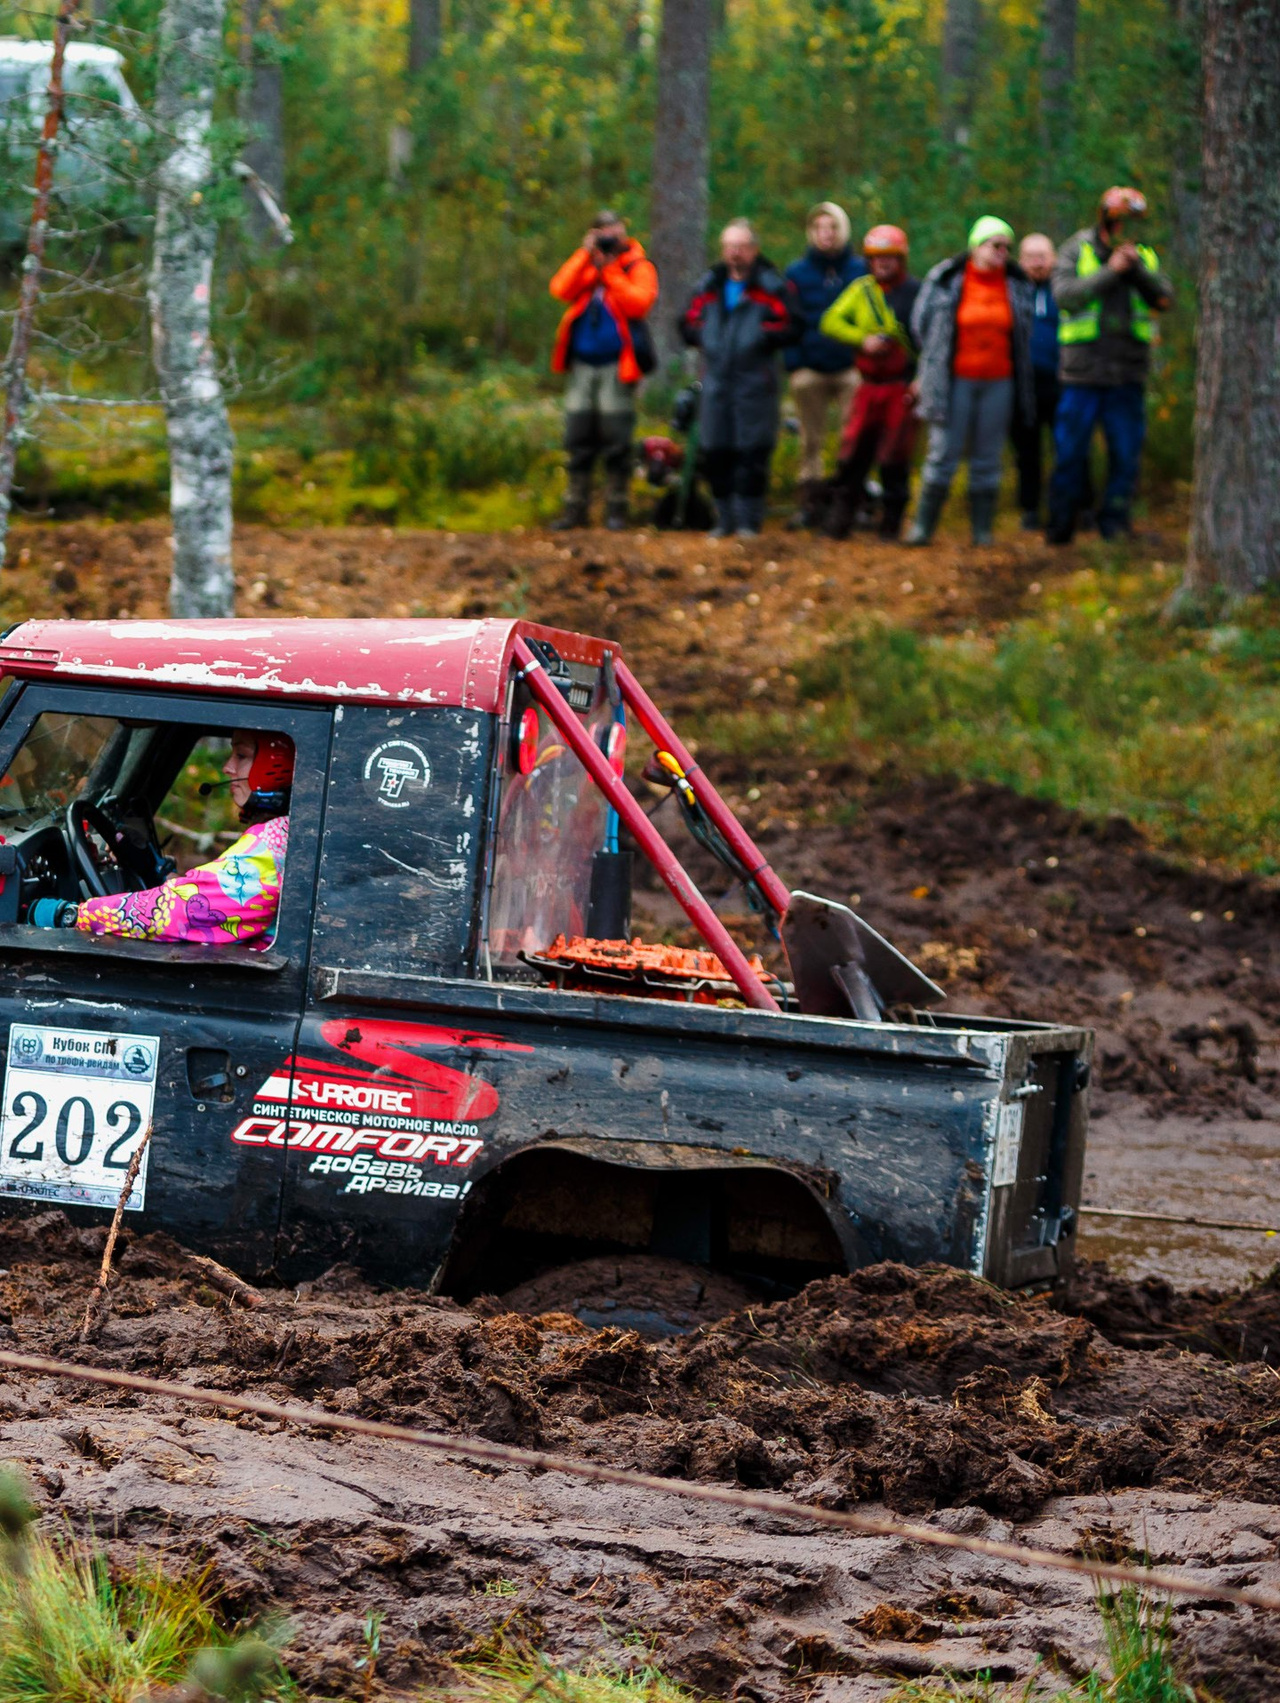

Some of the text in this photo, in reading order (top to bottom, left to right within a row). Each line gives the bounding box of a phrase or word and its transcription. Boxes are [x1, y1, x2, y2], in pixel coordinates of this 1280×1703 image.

[53, 1037, 90, 1052] Кубок
[9, 1091, 142, 1169] 202
[253, 1103, 479, 1138] СИНТЕТИЧЕСКОЕ МОТОРНОЕ МАСЛО
[233, 1118, 484, 1165] COMFORT
[309, 1154, 424, 1180] добавь
[344, 1174, 473, 1200] драйва!
